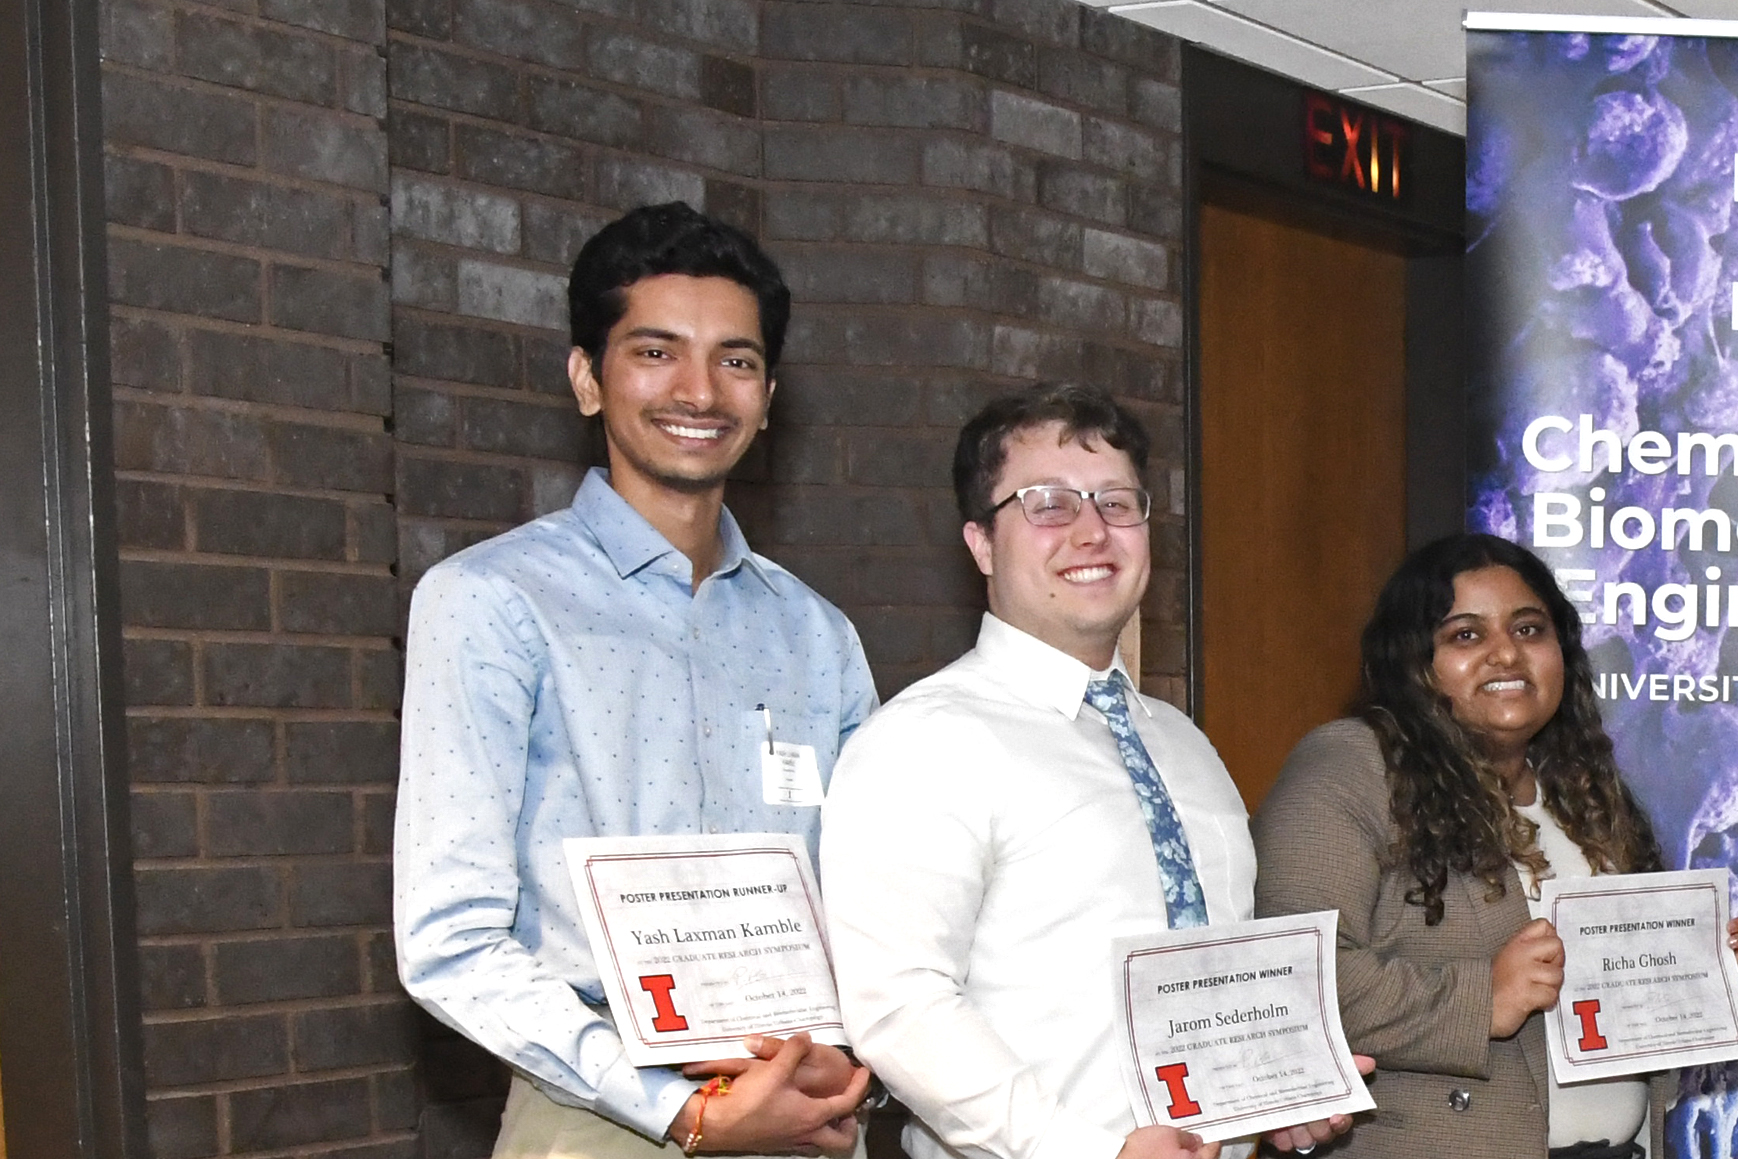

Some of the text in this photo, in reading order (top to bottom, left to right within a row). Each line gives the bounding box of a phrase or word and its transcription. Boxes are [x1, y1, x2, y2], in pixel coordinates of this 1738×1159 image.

[1306, 92, 1410, 199] EXIT
[620, 884, 788, 904] POSTER PRESENTATION RUNNER-UP
[631, 918, 803, 946] Yash Laxman Kamble
[1579, 918, 1696, 936] POSTER PRESENTATION WINNER
[672, 950, 716, 963] GRADUATE
[718, 947, 762, 960] RESEARCH
[763, 942, 811, 956] SYMPOSIUM
[1602, 951, 1677, 972] Richa Ghosh
[1157, 965, 1293, 995] POSTER PRESENTATION WINNER
[1601, 978, 1637, 989] GRADUATE
[1671, 971, 1709, 982] SYMPOSIUM
[1168, 1003, 1289, 1038] Jarom Sederholm
[1187, 1037, 1229, 1051] GRADUATE
[1229, 1030, 1266, 1044] RESEARCH
[1267, 1024, 1309, 1037] SYMPOSIUM
